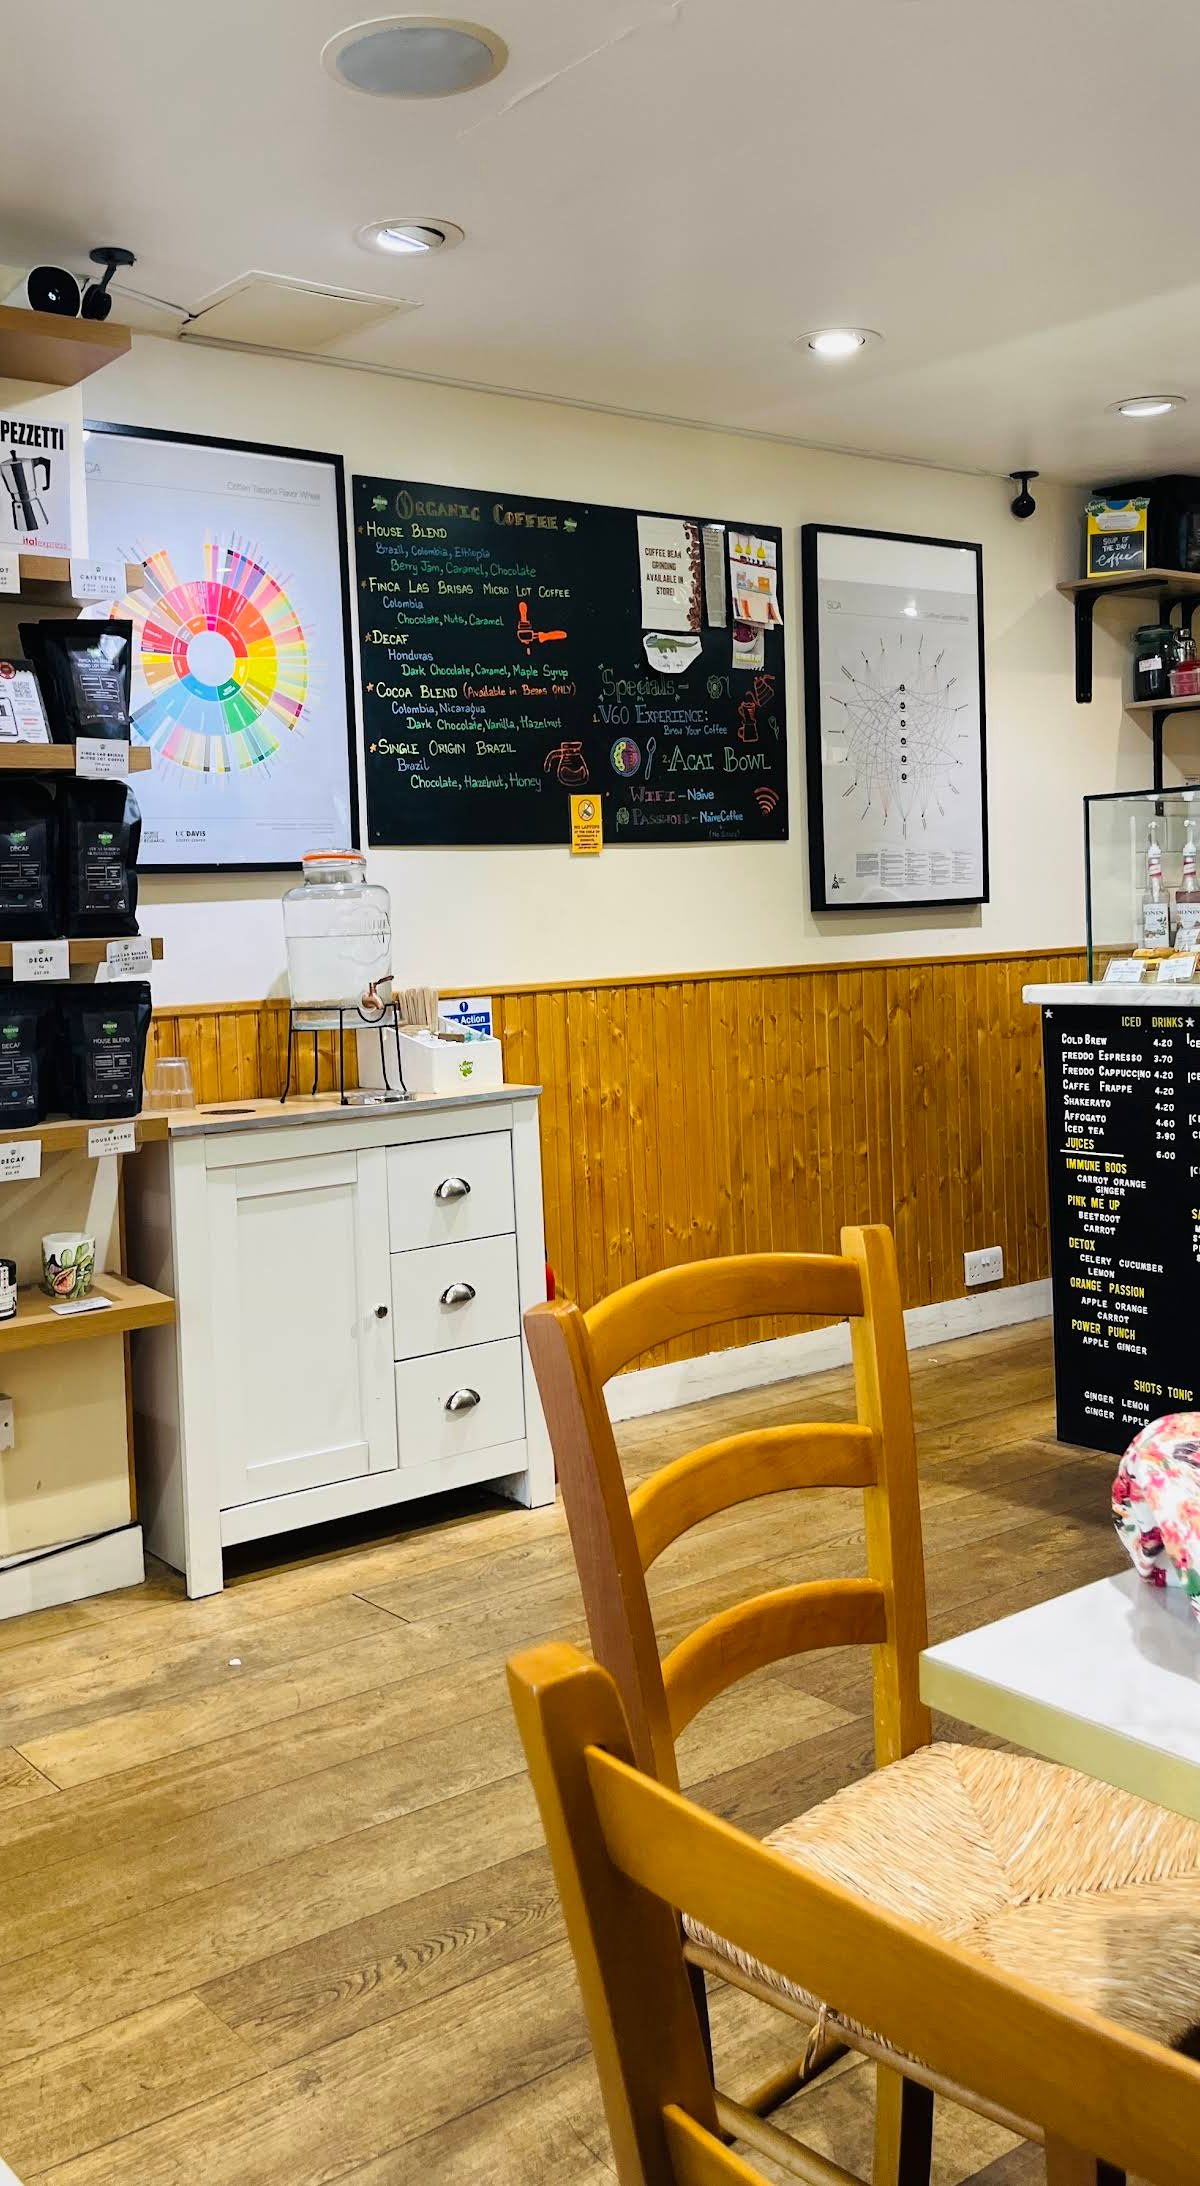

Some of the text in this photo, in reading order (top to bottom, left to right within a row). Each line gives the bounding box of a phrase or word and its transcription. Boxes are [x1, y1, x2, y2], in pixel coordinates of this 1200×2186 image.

[1, 420, 64, 450] PEZZETTI
[396, 490, 558, 530] ORGANIC COFFEE
[367, 522, 447, 539] HOUSE BLEND
[376, 543, 490, 560] Brazil, Colombia, Ethiopia
[645, 547, 682, 559] COFFEE BEAN
[390, 559, 536, 578] Berry Jam, Caramel, Chocolate
[646, 574, 684, 584] AVAILABLE IN
[369, 577, 571, 598] FINCA LAS BRISAS MICRO LOT COFFEE
[382, 596, 424, 609] Colombia
[397, 613, 504, 627] Chocolate, Nuts, Caramel
[372, 630, 409, 645] DECAF
[388, 649, 433, 662] Honduras
[401, 664, 568, 681] Dark Chocolate, Caramel, Maple Syrup
[376, 682, 413, 699] COCOA
[420, 684, 458, 699] BLEND
[463, 681, 506, 699] (Available
[509, 685, 517, 695] in
[602, 668, 676, 703] Specials
[392, 701, 486, 719] Colombia, Nicaragua
[406, 716, 562, 732] Dark Chocolate, Vanilla, Hazelnut
[663, 725, 728, 736] Brew Your Coffee
[378, 739, 516, 756] SINGLE ORIGIN BRAZIL
[398, 757, 430, 772] Brazil
[723, 747, 771, 772] BOWL
[410, 774, 541, 792] Chocolate, Hazelnut, Honey
[28, 956, 53, 964] DECAF
[461, 1015, 485, 1025] Action
[1122, 1016, 1184, 1028] ICED DRINKS
[1062, 1033, 1173, 1048] COLD BREW 4.20
[1062, 1050, 1173, 1064] FREDDO ESPRESSO 3.70
[1063, 1064, 1173, 1080] FREDDO CAPPUCCINO 4.20
[1063, 1080, 1174, 1096] CAFFE FRAPPE 4.20
[1064, 1095, 1174, 1112] SHAKERATO 4.20
[1065, 1110, 1175, 1128] AFFOGATO 4.60
[1065, 1122, 1175, 1140] ICED TEA 3.90
[1066, 1138, 1094, 1150] JUICES
[0, 1156, 24, 1164] DECAF
[1156, 1151, 1176, 1160] 6.00
[1066, 1158, 1127, 1174] IMMUNE BOOS
[1077, 1175, 1146, 1188] CARROT ORANGE
[1096, 1186, 1125, 1196] GINGER
[1068, 1195, 1120, 1210] PINK ME UP
[1078, 1211, 1120, 1223] BEETROOT
[1084, 1224, 1116, 1235] CARROT
[1069, 1237, 1095, 1251] DETOX
[1080, 1254, 1164, 1274] CELERY CUCUMBER
[1088, 1268, 1115, 1278] LEMON
[1070, 1277, 1144, 1298] ORANGE PASSION
[1081, 1296, 1148, 1314] APPLE ORANGE
[1097, 1312, 1130, 1324] CARROT
[1072, 1319, 1136, 1340] POWER PUNCH
[1083, 1336, 1147, 1355] APPLE GINGER
[1134, 1380, 1193, 1402] SHOTS TONIC
[1084, 1391, 1150, 1412] GINGER LEMON
[1085, 1406, 1150, 1427] GINGER APPLE
